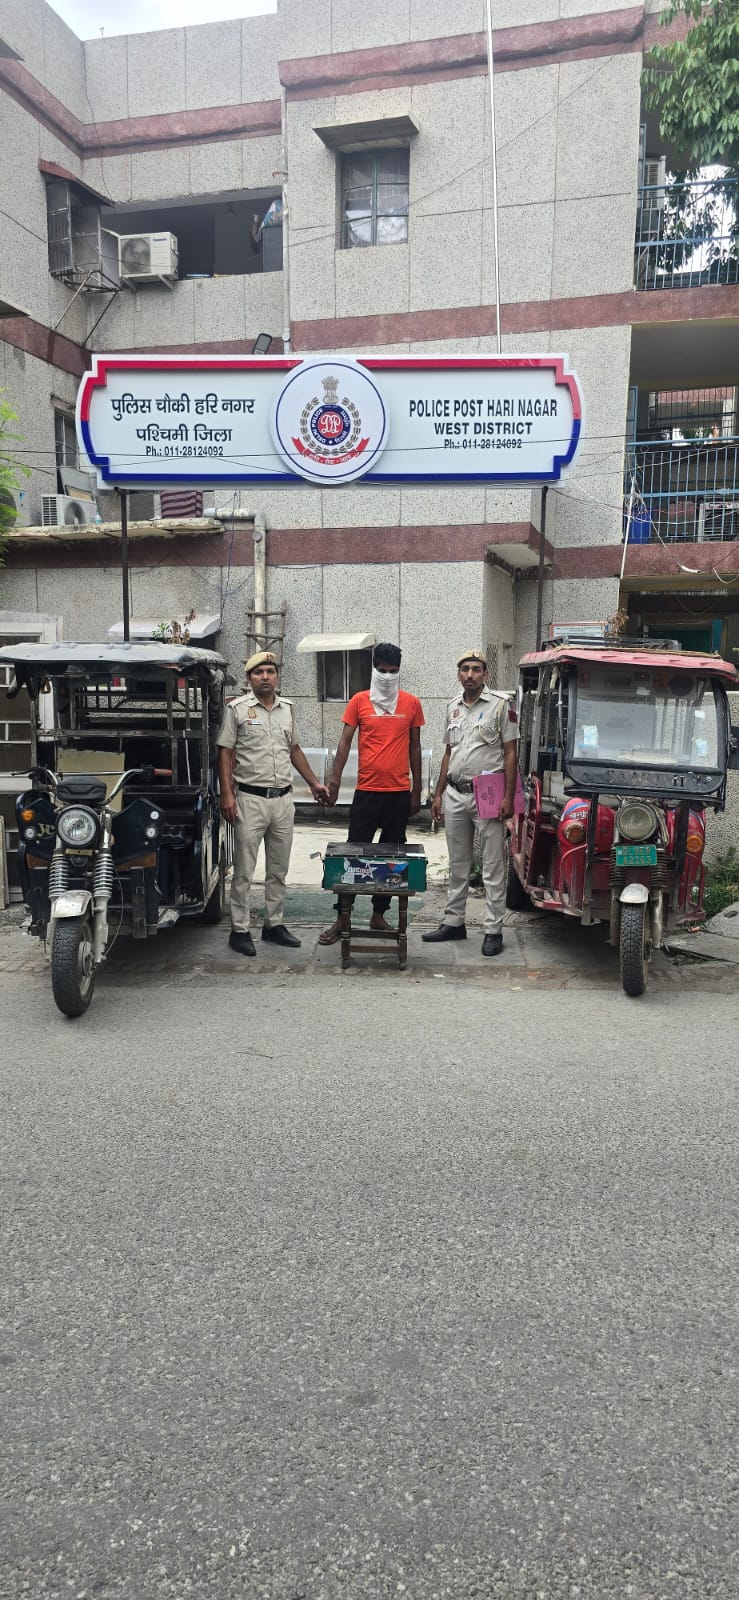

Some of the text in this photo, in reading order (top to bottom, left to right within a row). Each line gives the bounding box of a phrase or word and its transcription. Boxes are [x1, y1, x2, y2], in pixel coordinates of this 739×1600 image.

[111, 393, 255, 421] पुलिस चौकी हरि नगर
[409, 399, 557, 417] POLICE POST HARI NAGAR
[136, 424, 232, 442] पश्चिमी जिला
[434, 422, 533, 435] WEST DISTRICT
[145, 446, 223, 456] Ph.: 011-28124092
[444, 439, 522, 449] Ph.: 011-28124092
